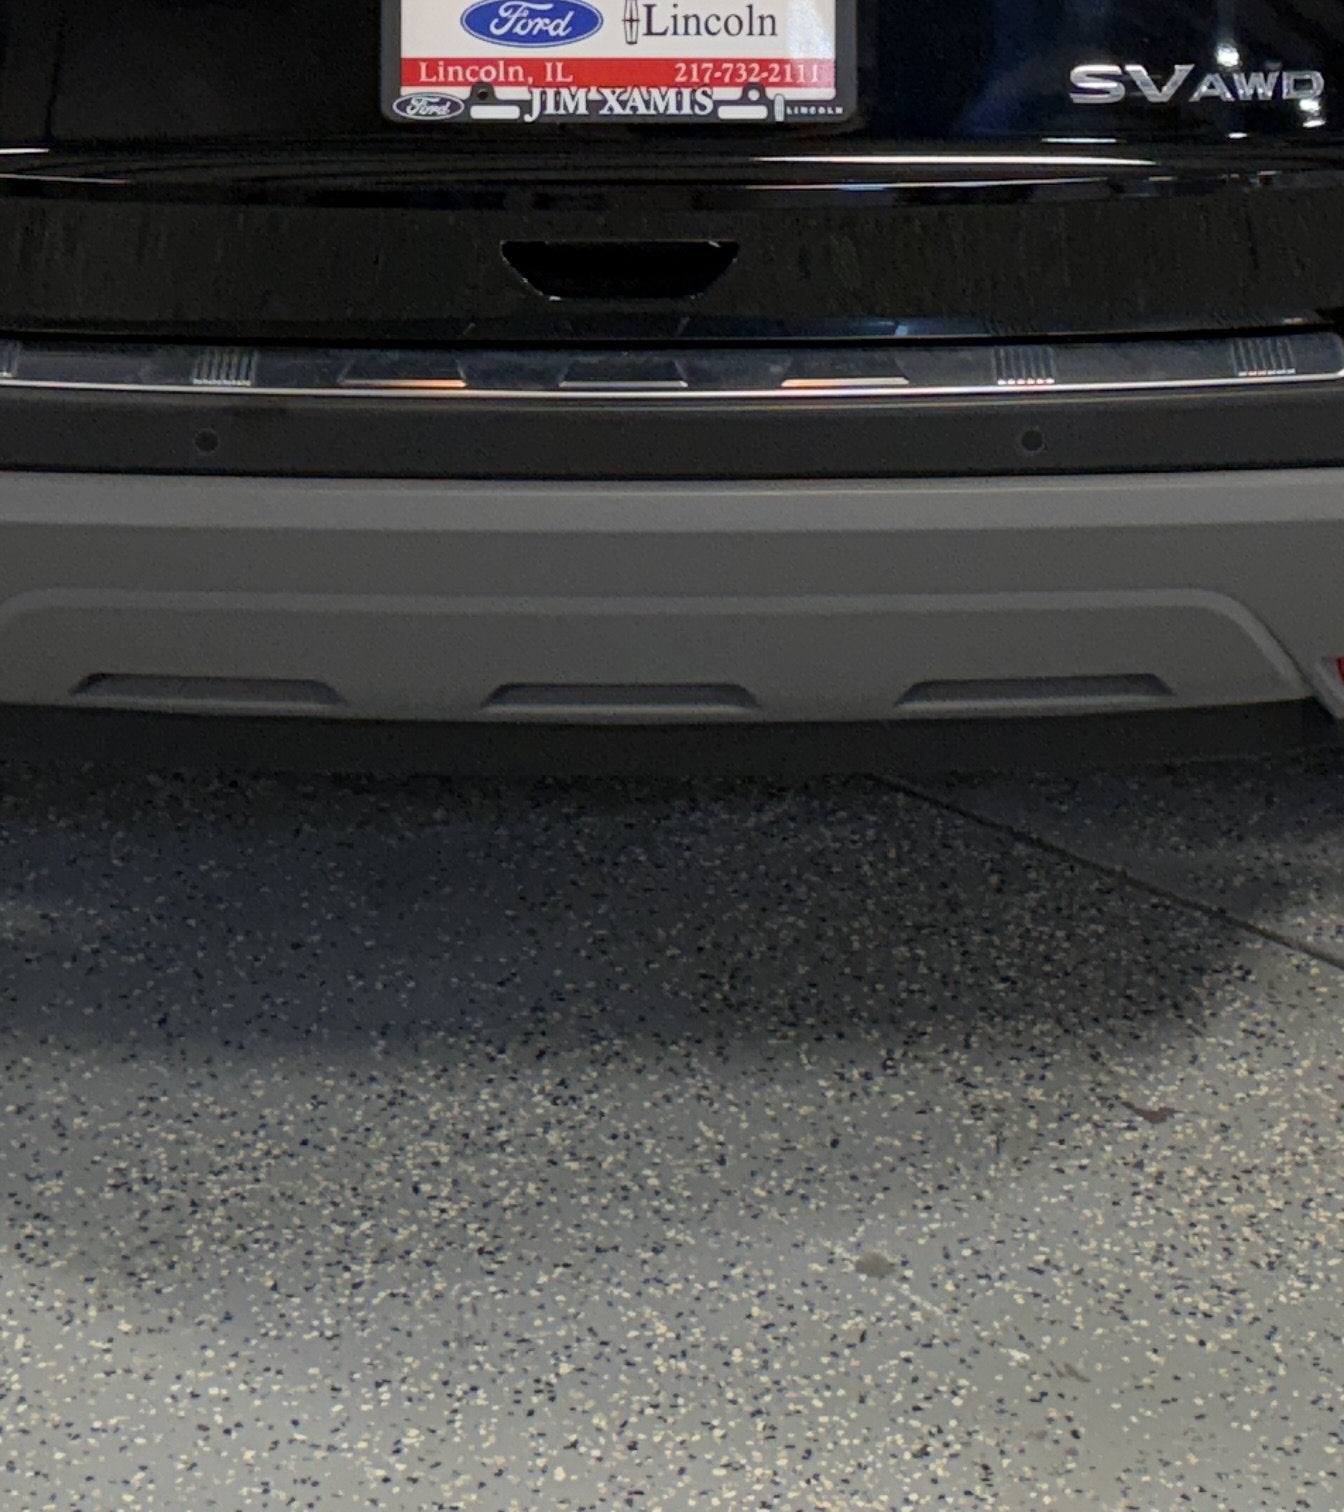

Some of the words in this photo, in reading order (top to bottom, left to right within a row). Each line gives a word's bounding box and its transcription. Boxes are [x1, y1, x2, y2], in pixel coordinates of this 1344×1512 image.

[489, 0, 574, 38] Ford
[643, 3, 778, 37] Lincoln
[419, 61, 534, 84] Lincoln,
[545, 61, 573, 82] IL
[674, 62, 820, 83] 217-732-2111
[1069, 64, 1195, 104] SV
[1188, 70, 1325, 102] AWD
[406, 95, 452, 116] Ford
[523, 87, 589, 122] JIM
[598, 87, 715, 116] XAMIS
[786, 105, 844, 115] LINCOLN
